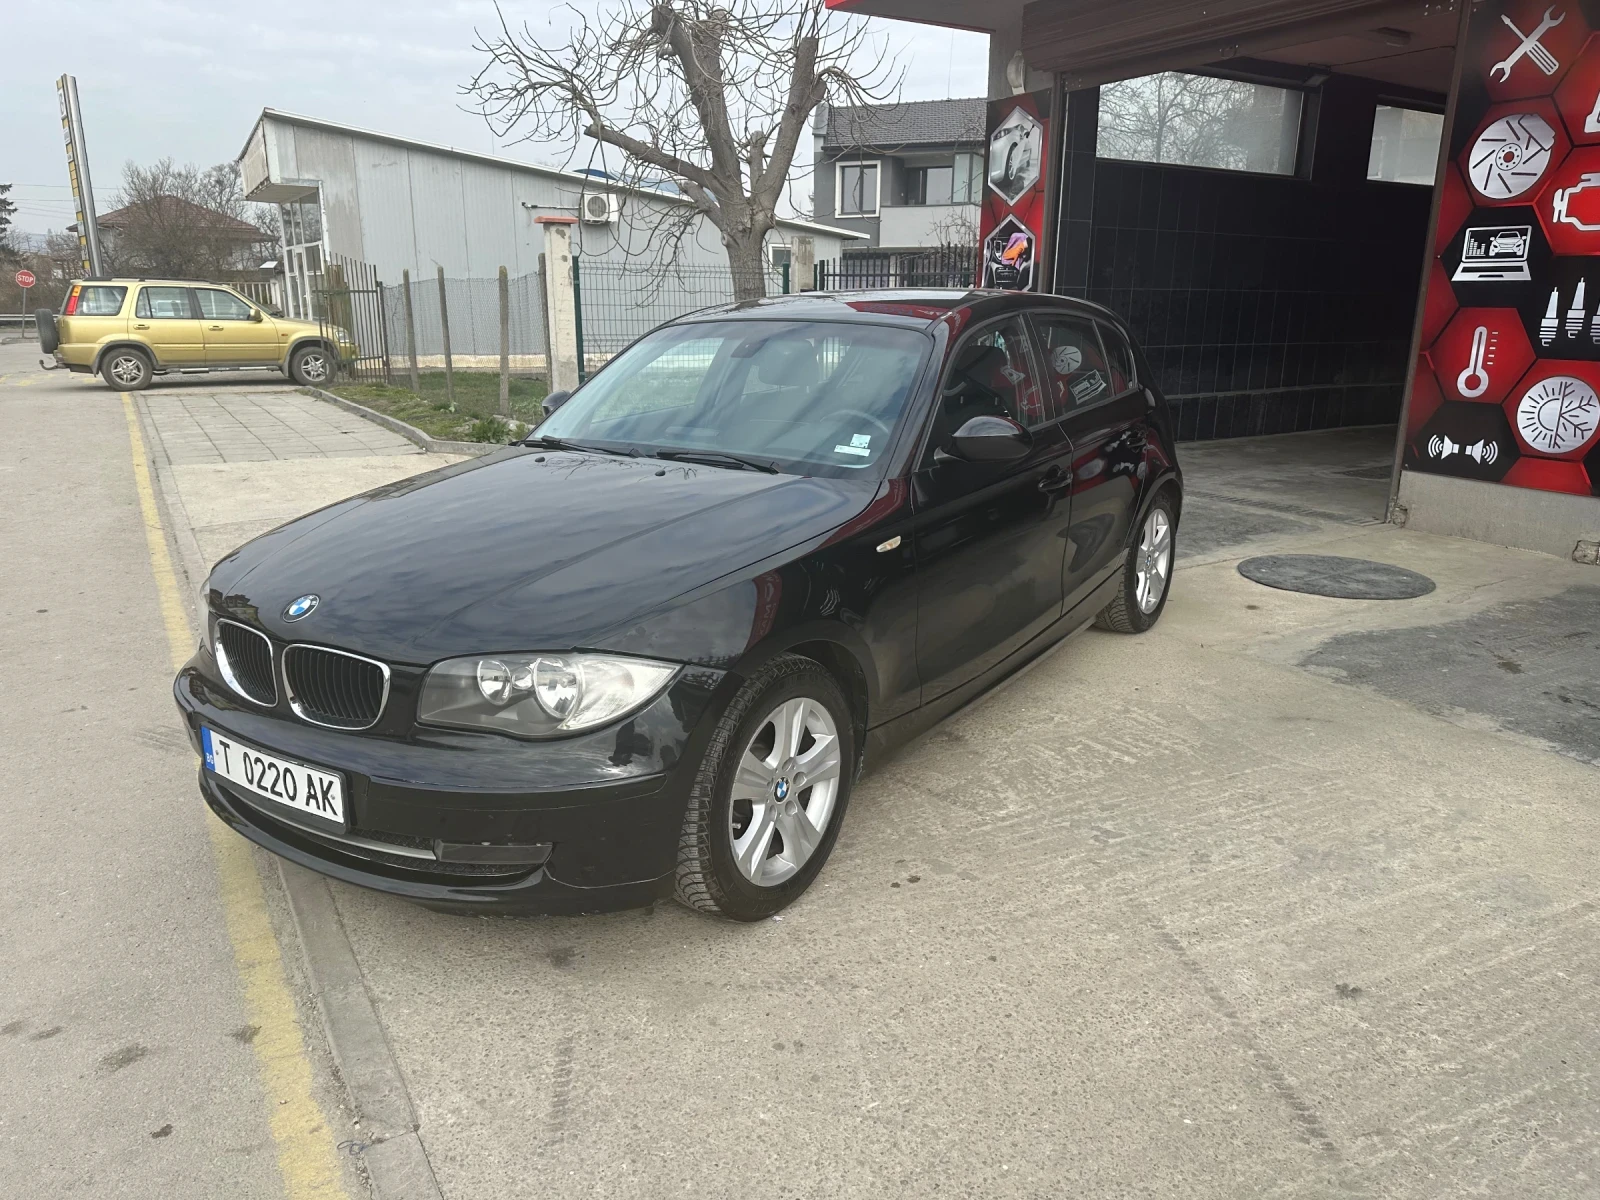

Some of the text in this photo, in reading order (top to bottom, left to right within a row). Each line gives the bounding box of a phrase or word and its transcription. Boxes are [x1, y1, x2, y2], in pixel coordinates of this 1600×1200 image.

[17, 275, 33, 283] STOP
[219, 740, 338, 816] T 0220 AK
